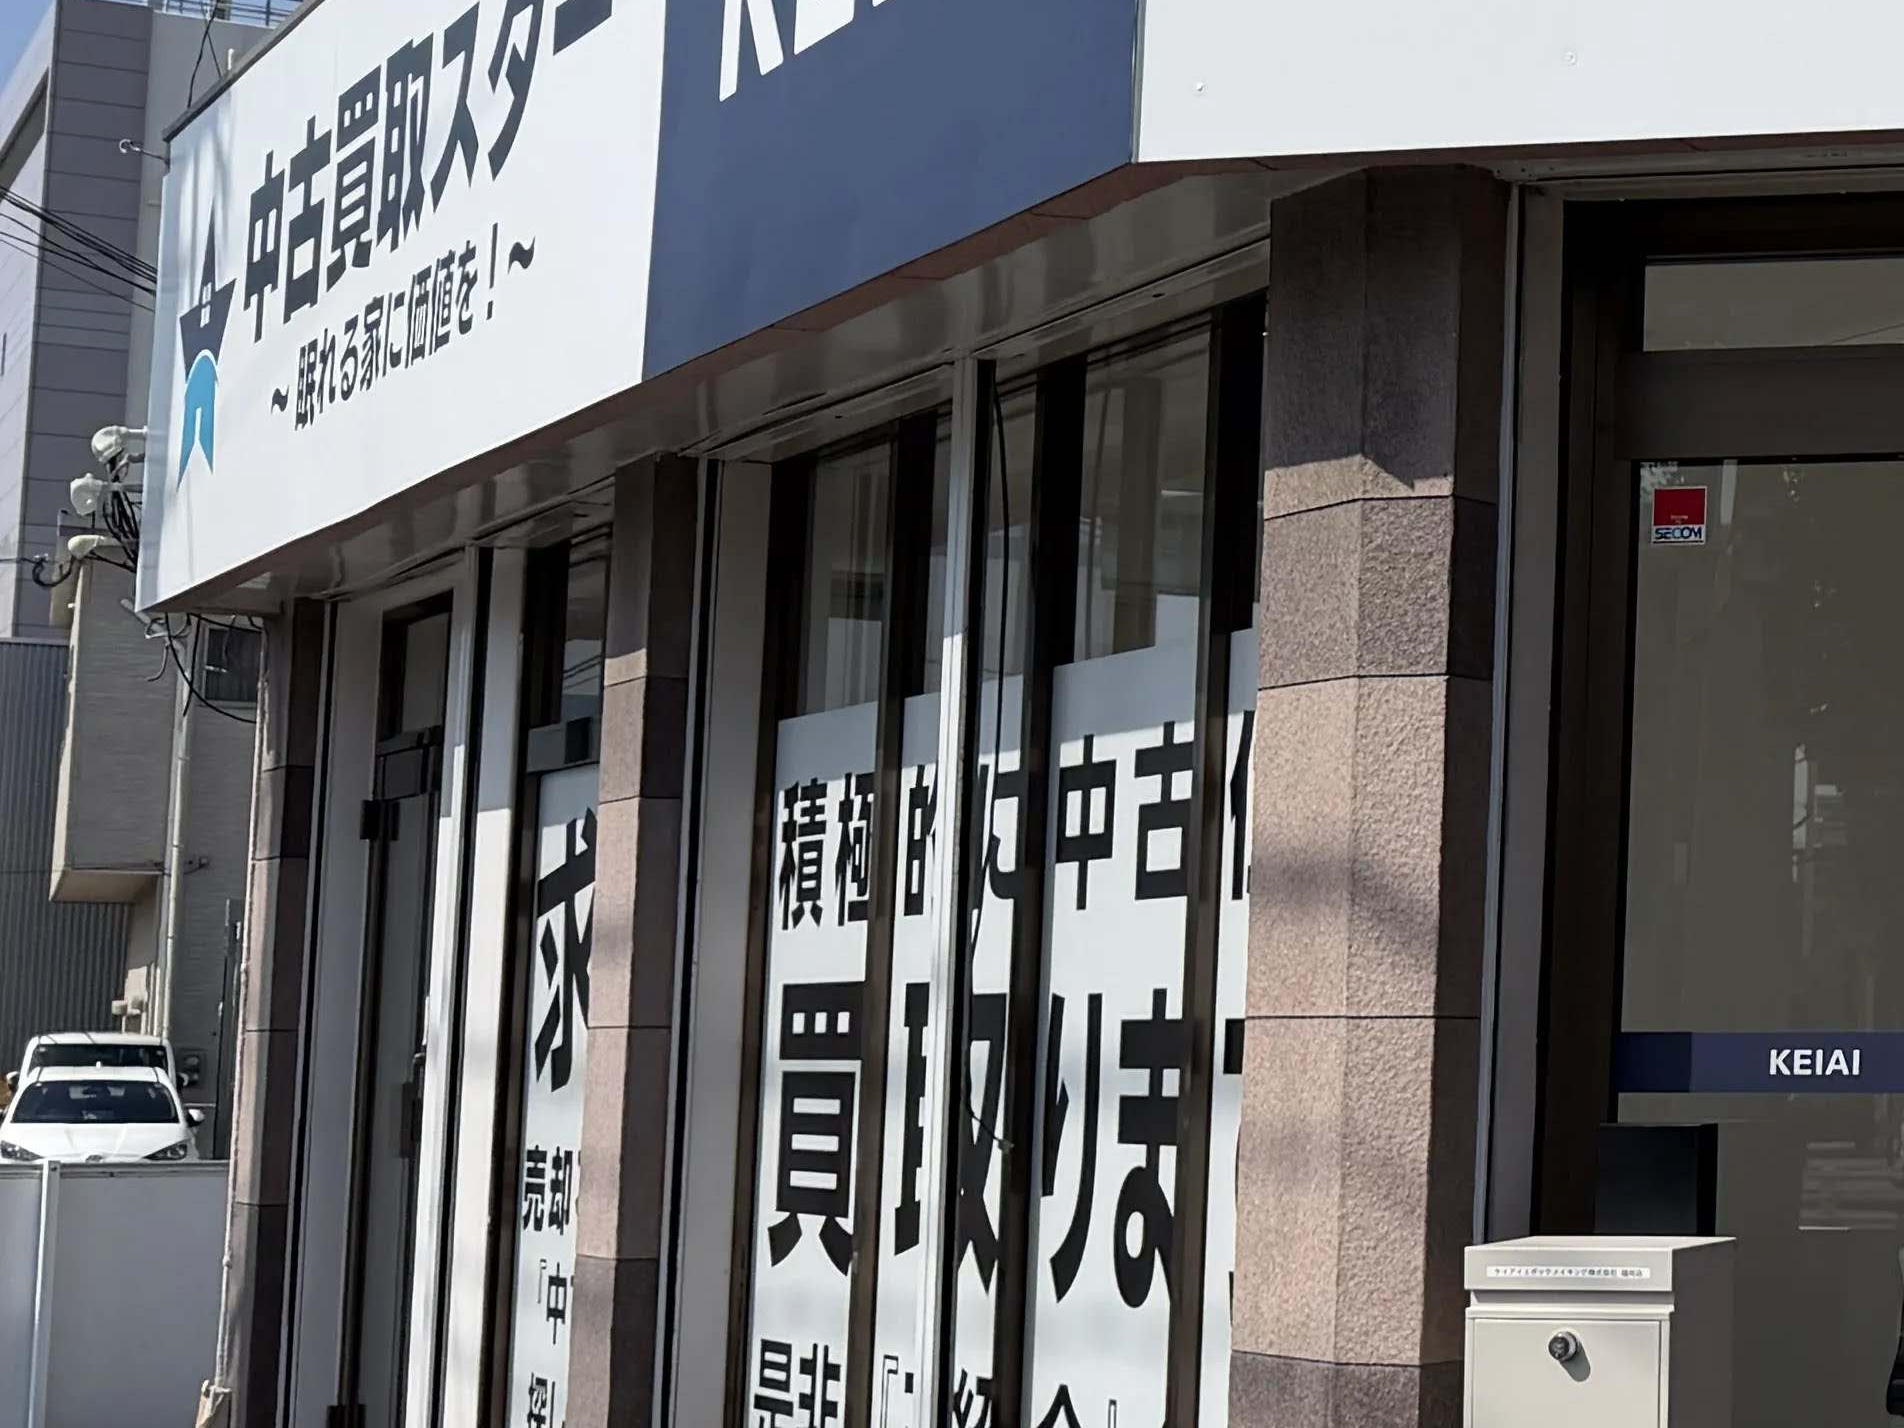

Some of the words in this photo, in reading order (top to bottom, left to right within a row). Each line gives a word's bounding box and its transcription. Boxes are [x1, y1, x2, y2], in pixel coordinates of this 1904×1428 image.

[1655, 527, 1702, 540] SECOM
[1769, 1049, 1860, 1075] KEIAI
[768, 981, 1246, 1327] 買取りま
[523, 1145, 581, 1235] 売却
